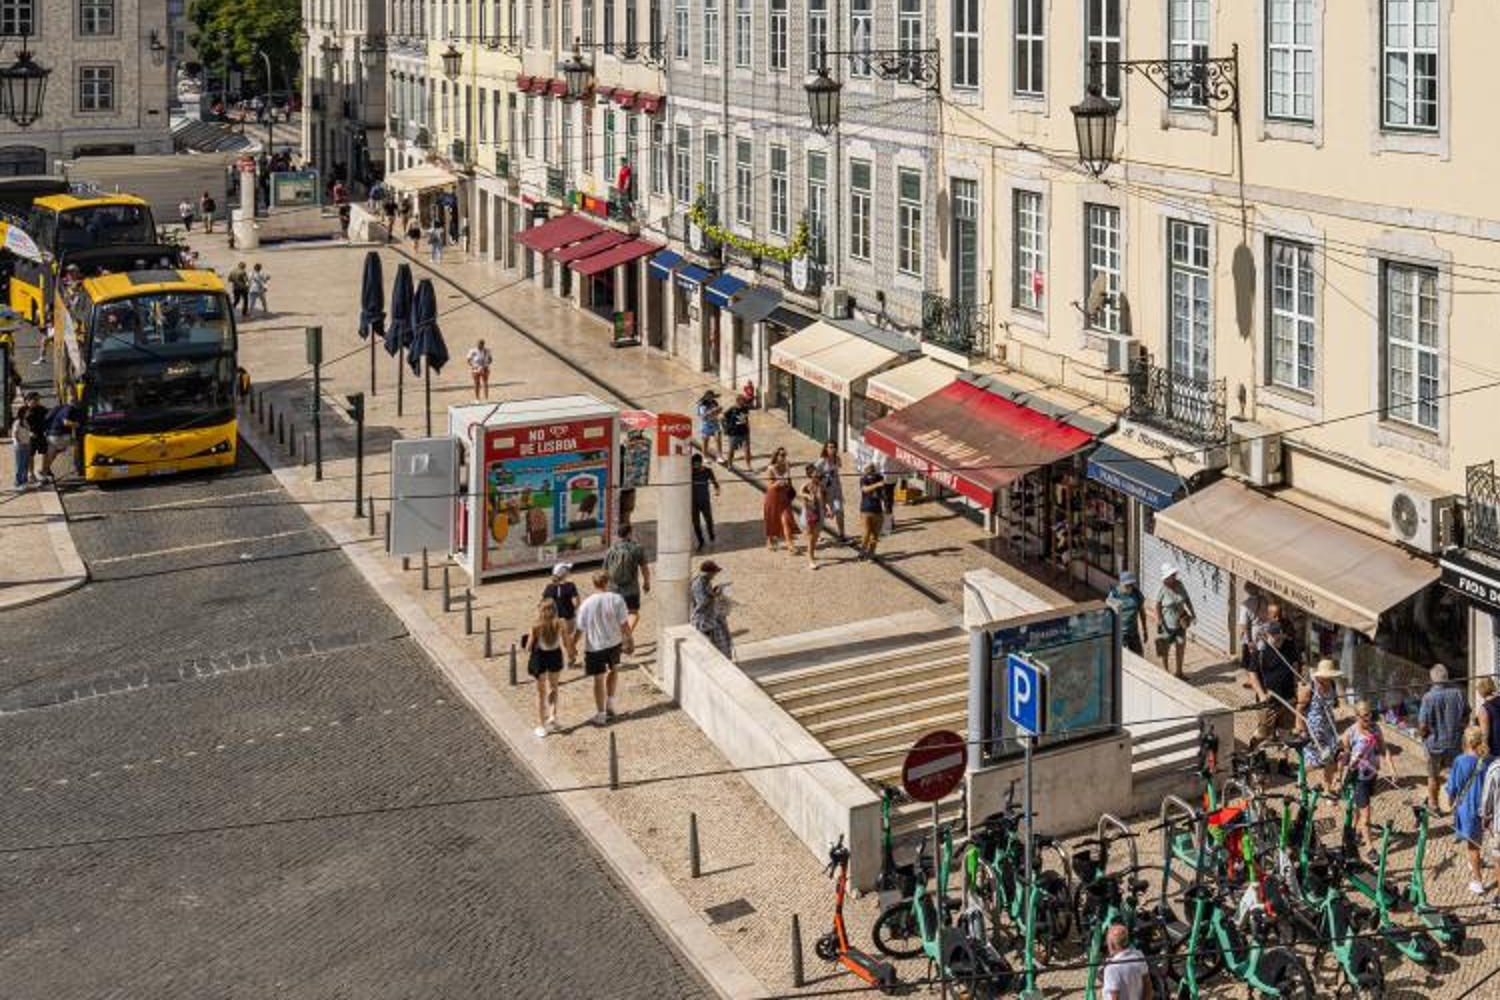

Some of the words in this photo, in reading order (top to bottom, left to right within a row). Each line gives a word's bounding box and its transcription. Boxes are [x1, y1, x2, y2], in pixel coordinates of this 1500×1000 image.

[537, 437, 577, 454] LISBOA
[1458, 577, 1486, 598] FIOS
[1013, 665, 1031, 717] P
